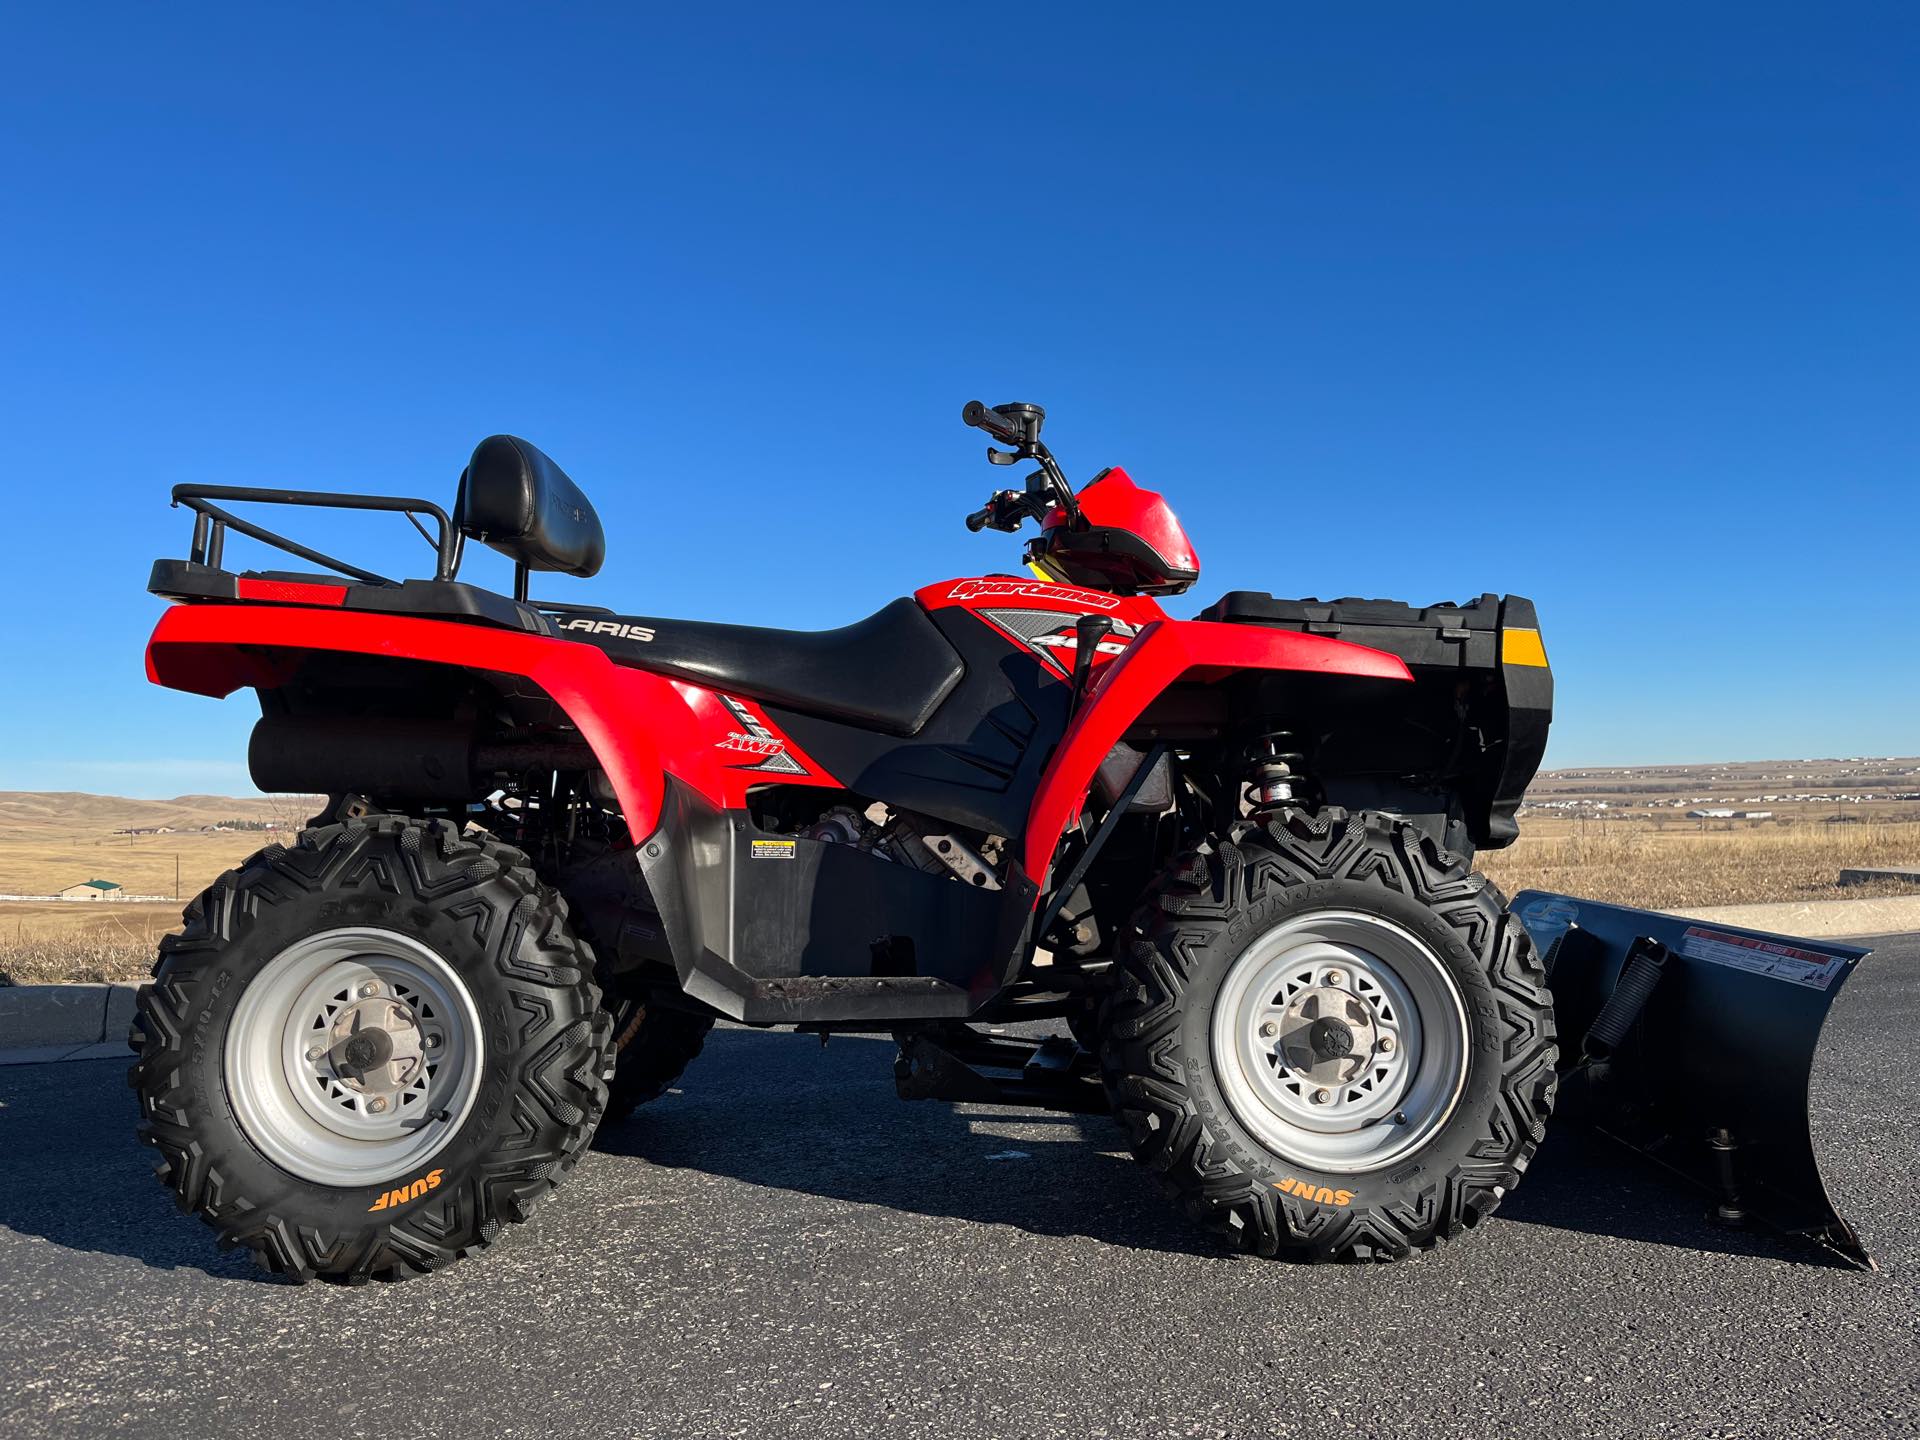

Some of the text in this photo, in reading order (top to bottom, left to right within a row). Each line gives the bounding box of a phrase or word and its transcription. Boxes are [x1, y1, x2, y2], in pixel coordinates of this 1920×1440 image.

[556, 617, 656, 641] LARIS
[1028, 632, 1128, 655] 40
[713, 738, 785, 756] AWD
[1424, 916, 1501, 1054] POWER
[368, 1168, 445, 1212] SUNF
[1273, 1176, 1356, 1207] SUNF
